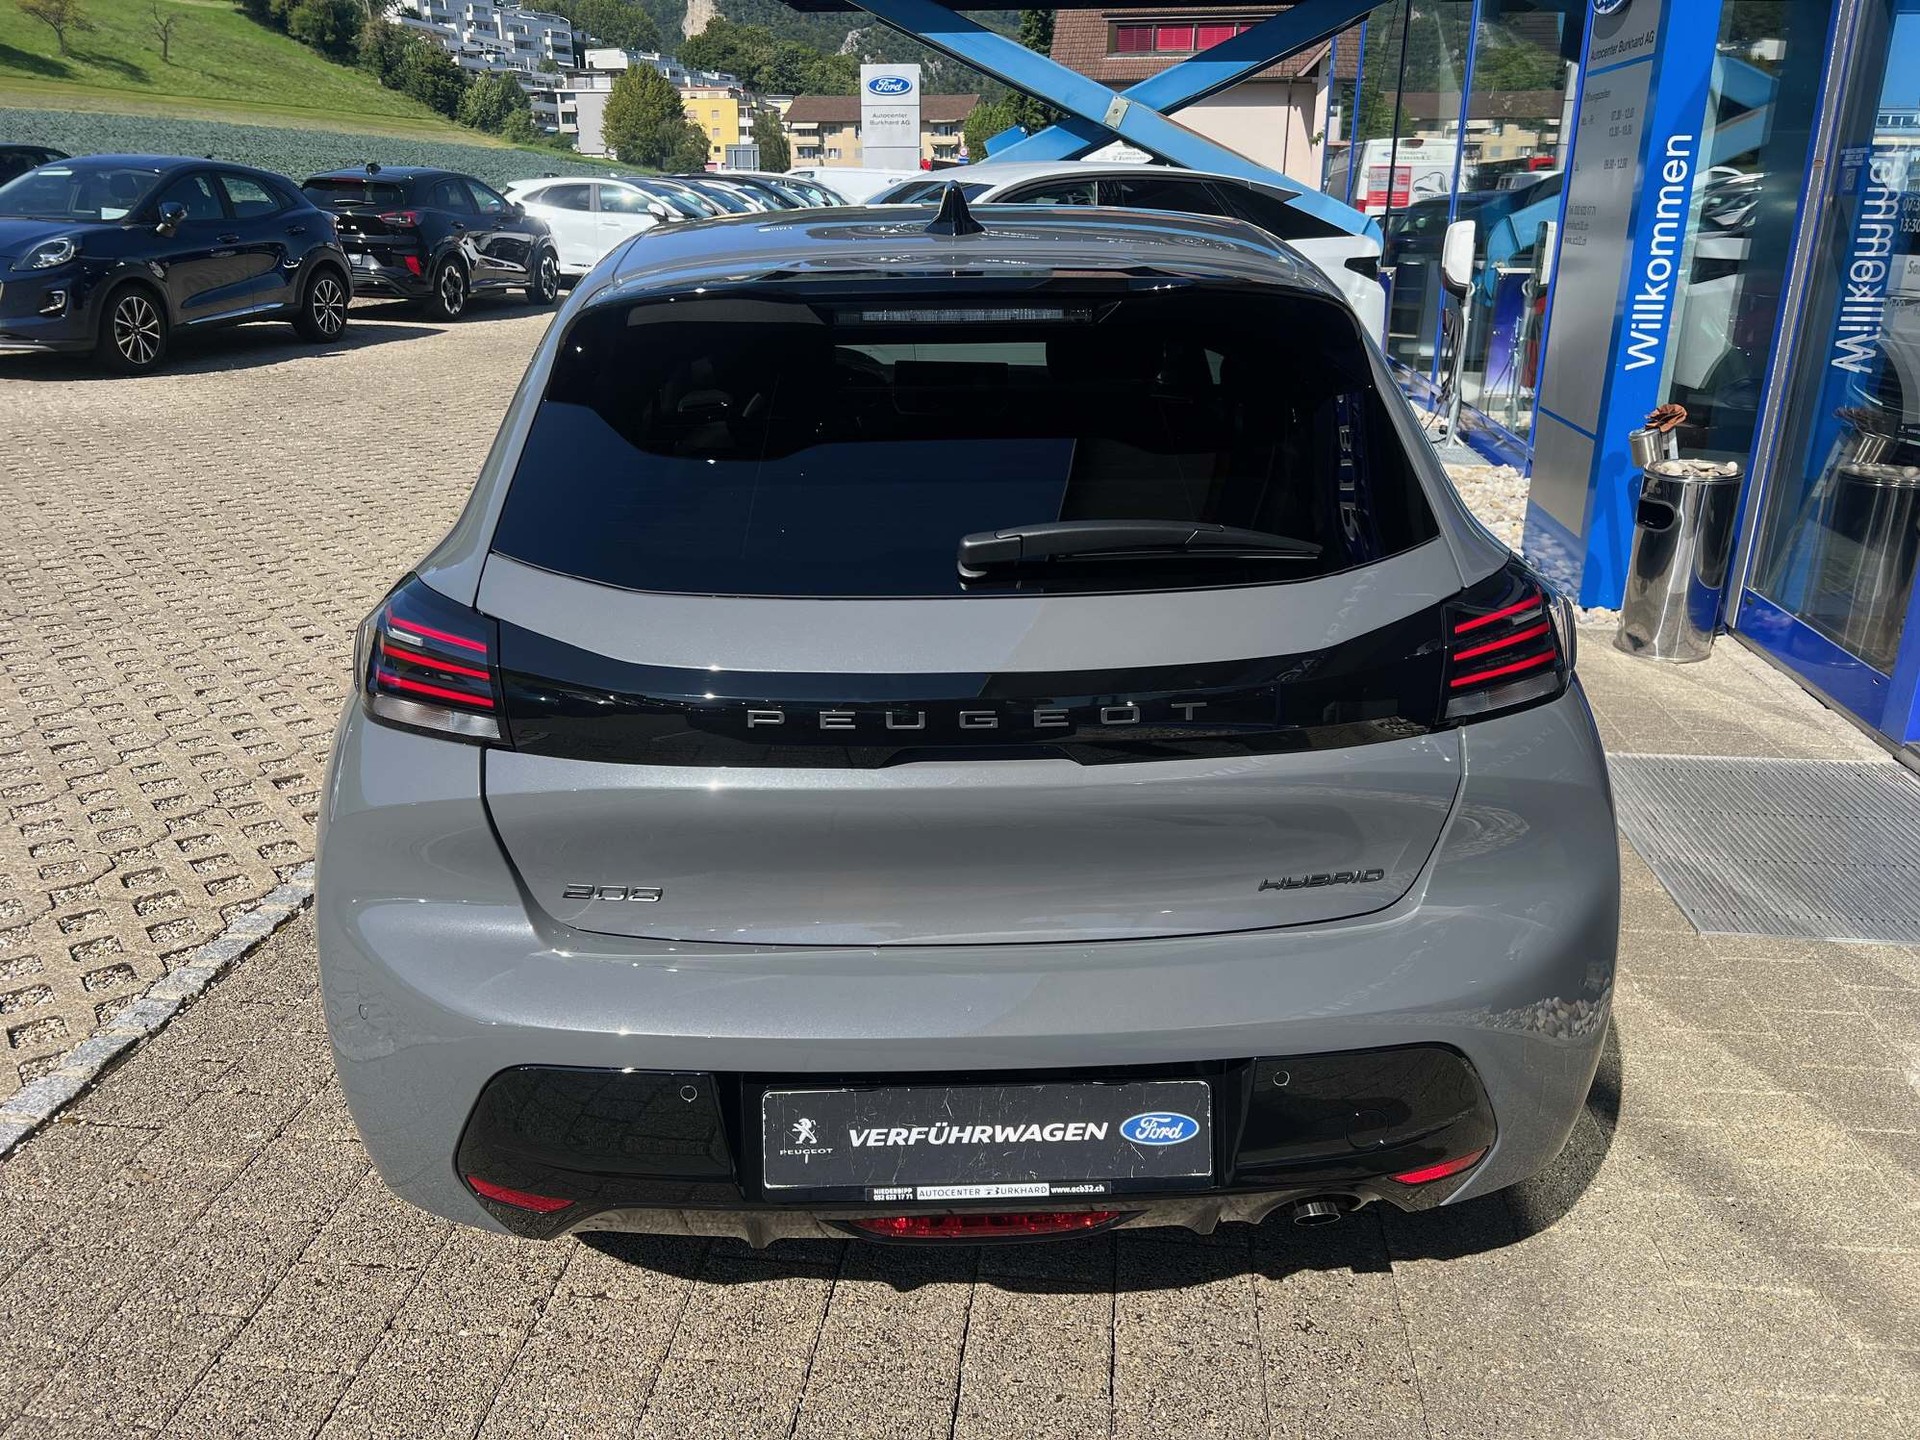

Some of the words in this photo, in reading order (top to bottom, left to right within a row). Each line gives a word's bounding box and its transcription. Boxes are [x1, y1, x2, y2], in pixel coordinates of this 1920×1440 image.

[876, 79, 902, 91] Ford
[1625, 134, 1693, 371] Willkommen
[747, 701, 1208, 730] PEUGEOT
[1258, 868, 1384, 891] HYBRID
[562, 883, 663, 902] 208
[849, 1122, 1109, 1147] VERFÜHRWAGEN
[1135, 1116, 1183, 1140] Ford
[779, 1148, 833, 1156] PEUGEOT
[919, 1187, 981, 1198] AUTOCENTER
